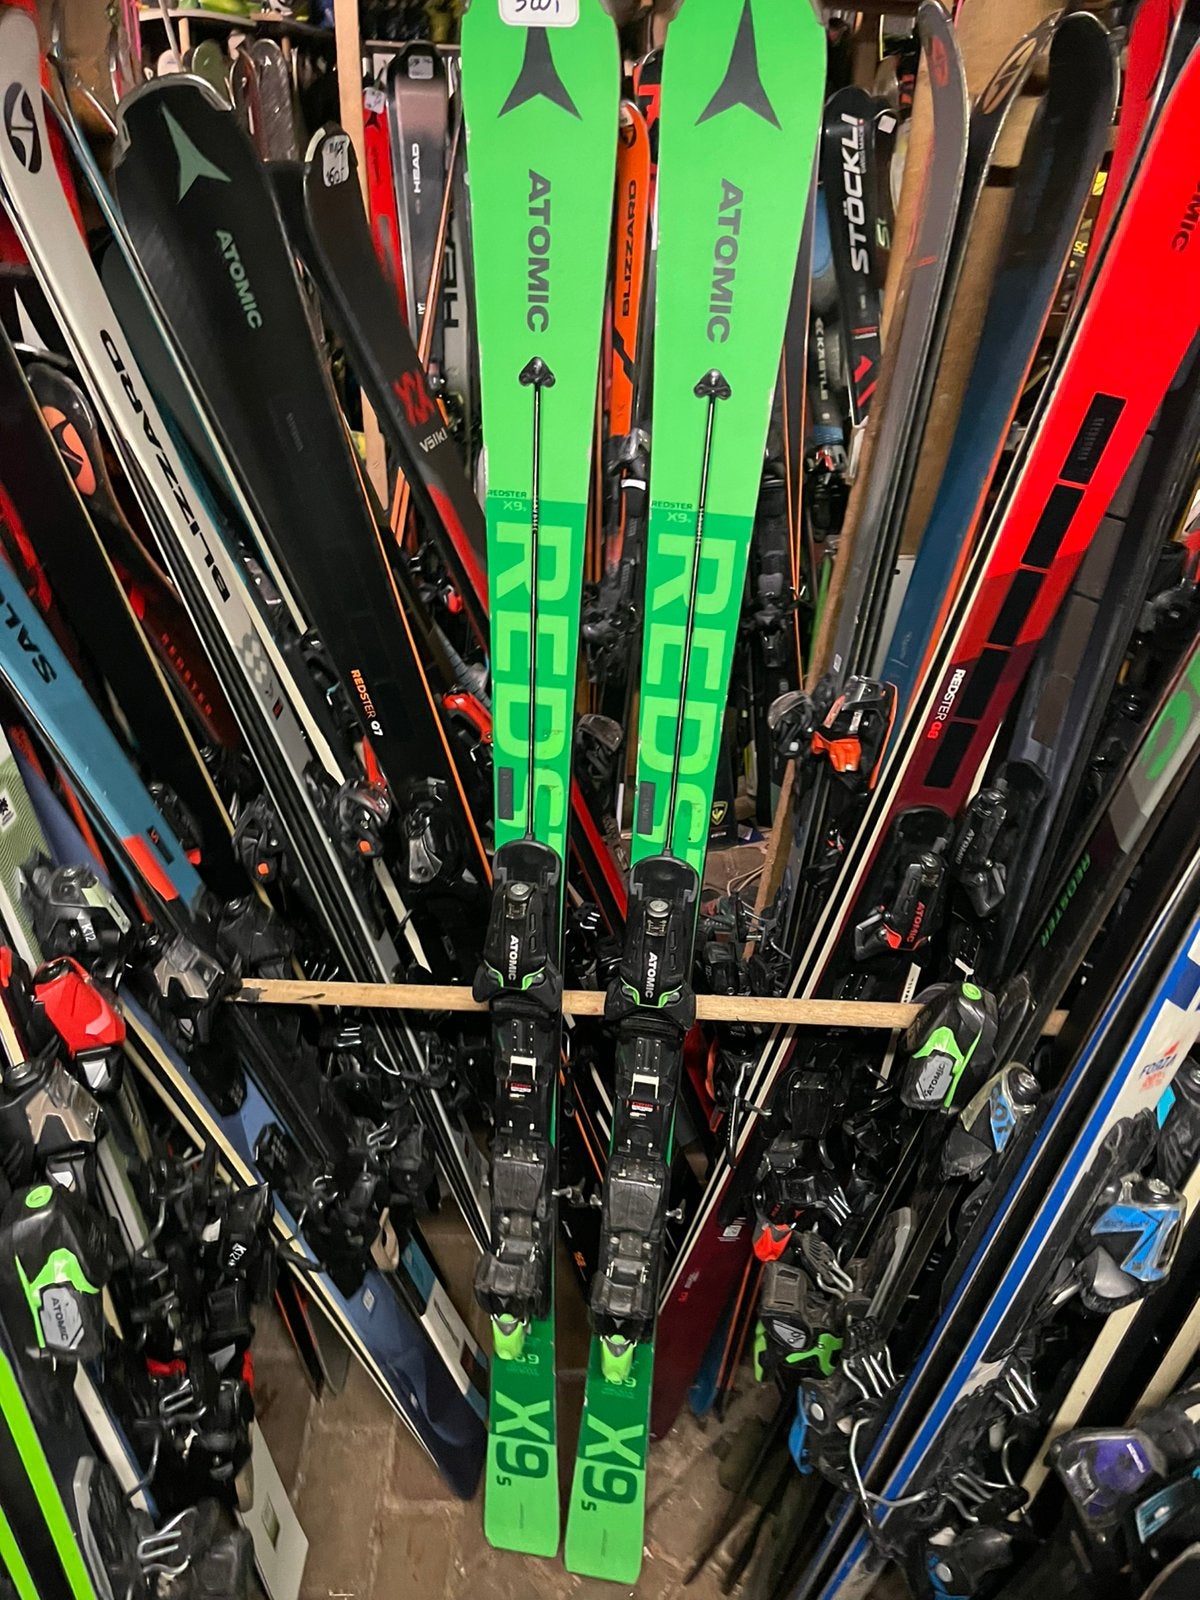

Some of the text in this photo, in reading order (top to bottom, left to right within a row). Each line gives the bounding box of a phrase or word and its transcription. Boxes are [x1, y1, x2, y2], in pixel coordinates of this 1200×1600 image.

[412, 143, 422, 193] HEAD
[841, 113, 870, 274] STÖCKLI
[527, 169, 552, 333] ATOMIC
[622, 179, 637, 316] BLIZZARD
[1171, 180, 1200, 252] MIC
[216, 229, 263, 330] ATOMIC
[706, 178, 744, 343] ATOMIC
[100, 329, 231, 603] BLIZZARD
[650, 500, 694, 510] REDSTER
[0, 588, 58, 684] SAL
[351, 669, 384, 737] REDSTER Q7
[495, 521, 573, 856] REDS
[637, 533, 737, 874] REDS
[935, 668, 967, 721] REDSTER
[907, 901, 926, 942] ATOMIC
[507, 934, 520, 982] ATOMIC
[645, 951, 659, 999] ATOMIC
[927, 1061, 947, 1096] ATOMIC
[51, 1297, 69, 1341] ATOMIC
